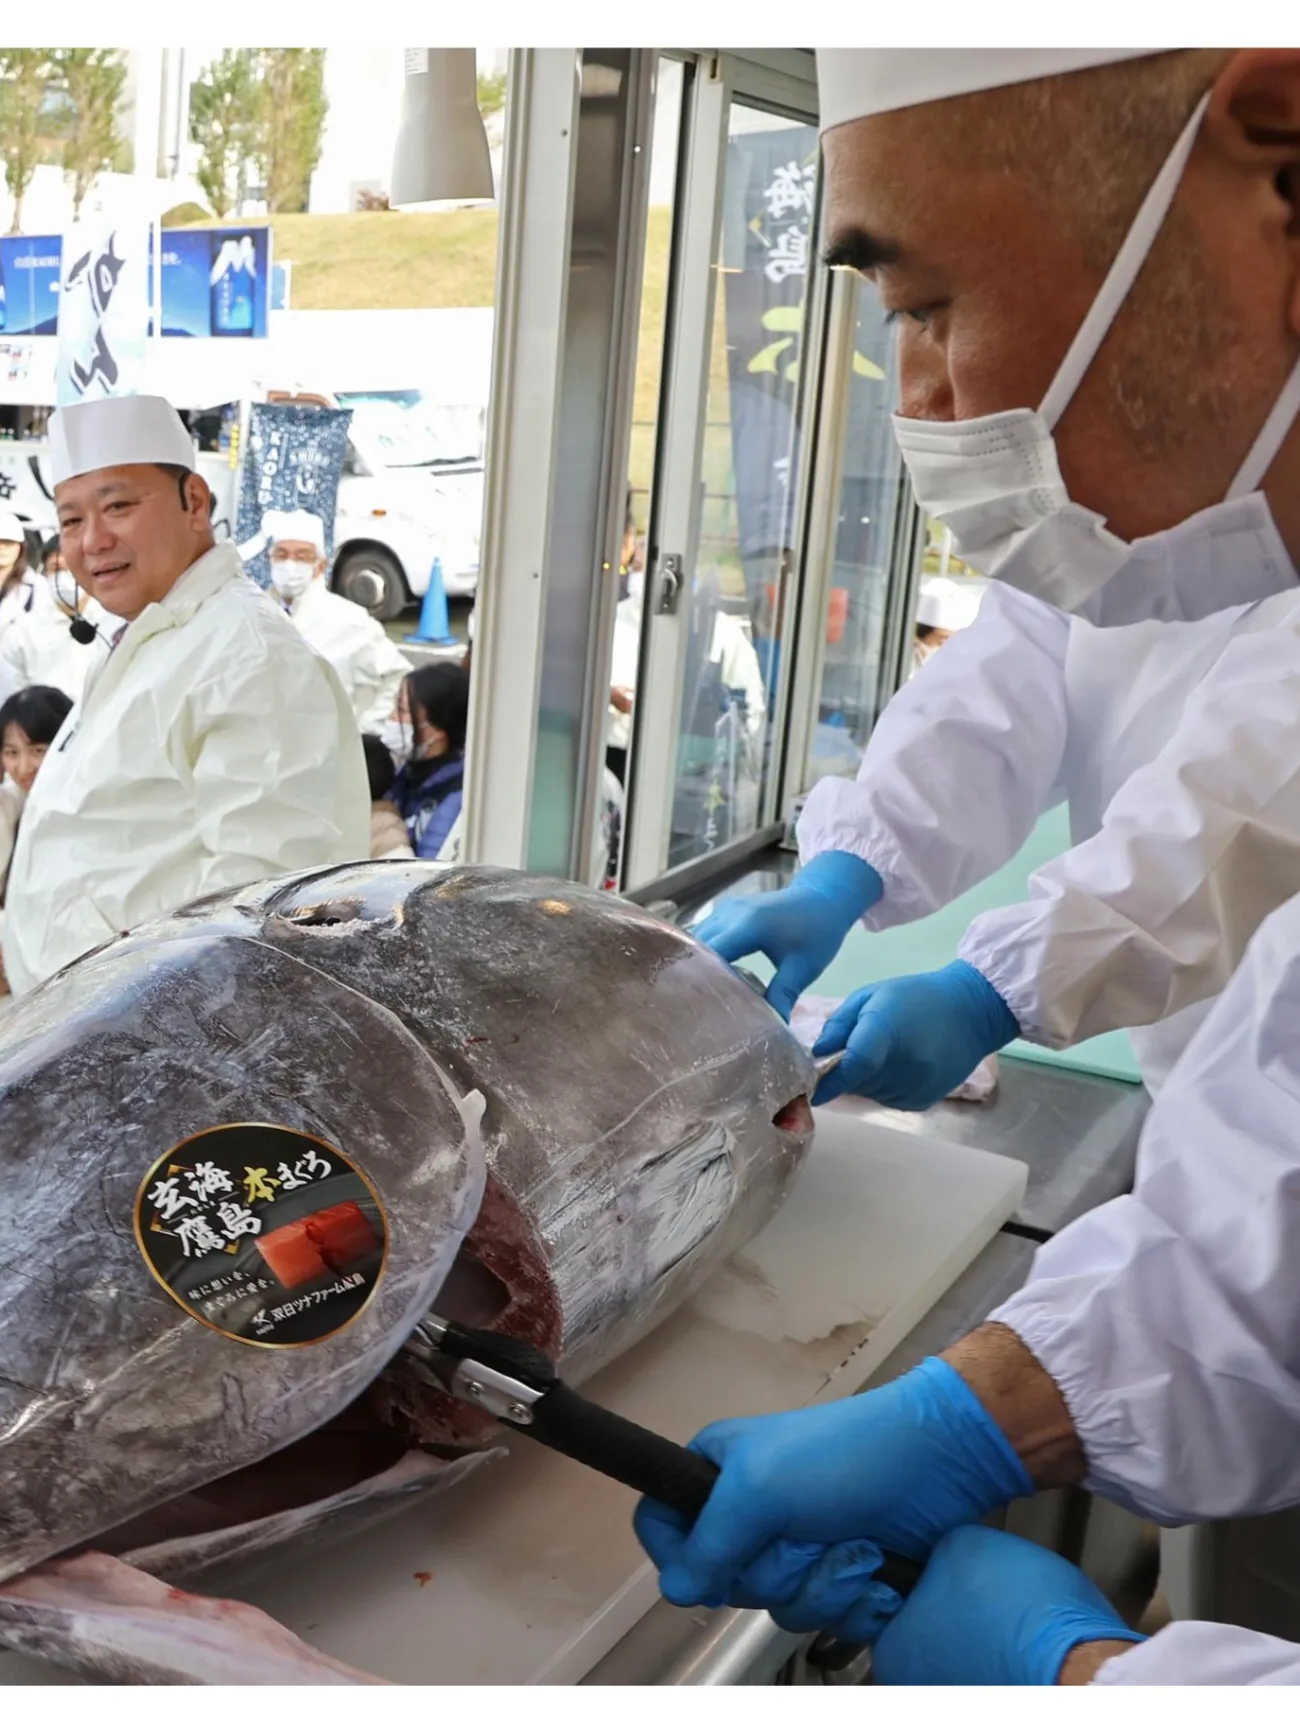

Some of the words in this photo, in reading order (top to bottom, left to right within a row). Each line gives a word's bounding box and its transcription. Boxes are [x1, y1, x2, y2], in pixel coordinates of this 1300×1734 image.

[147, 1161, 234, 1220] 玄海
[243, 1150, 333, 1203] 本まぐろ
[174, 1201, 262, 1258] 鷹島
